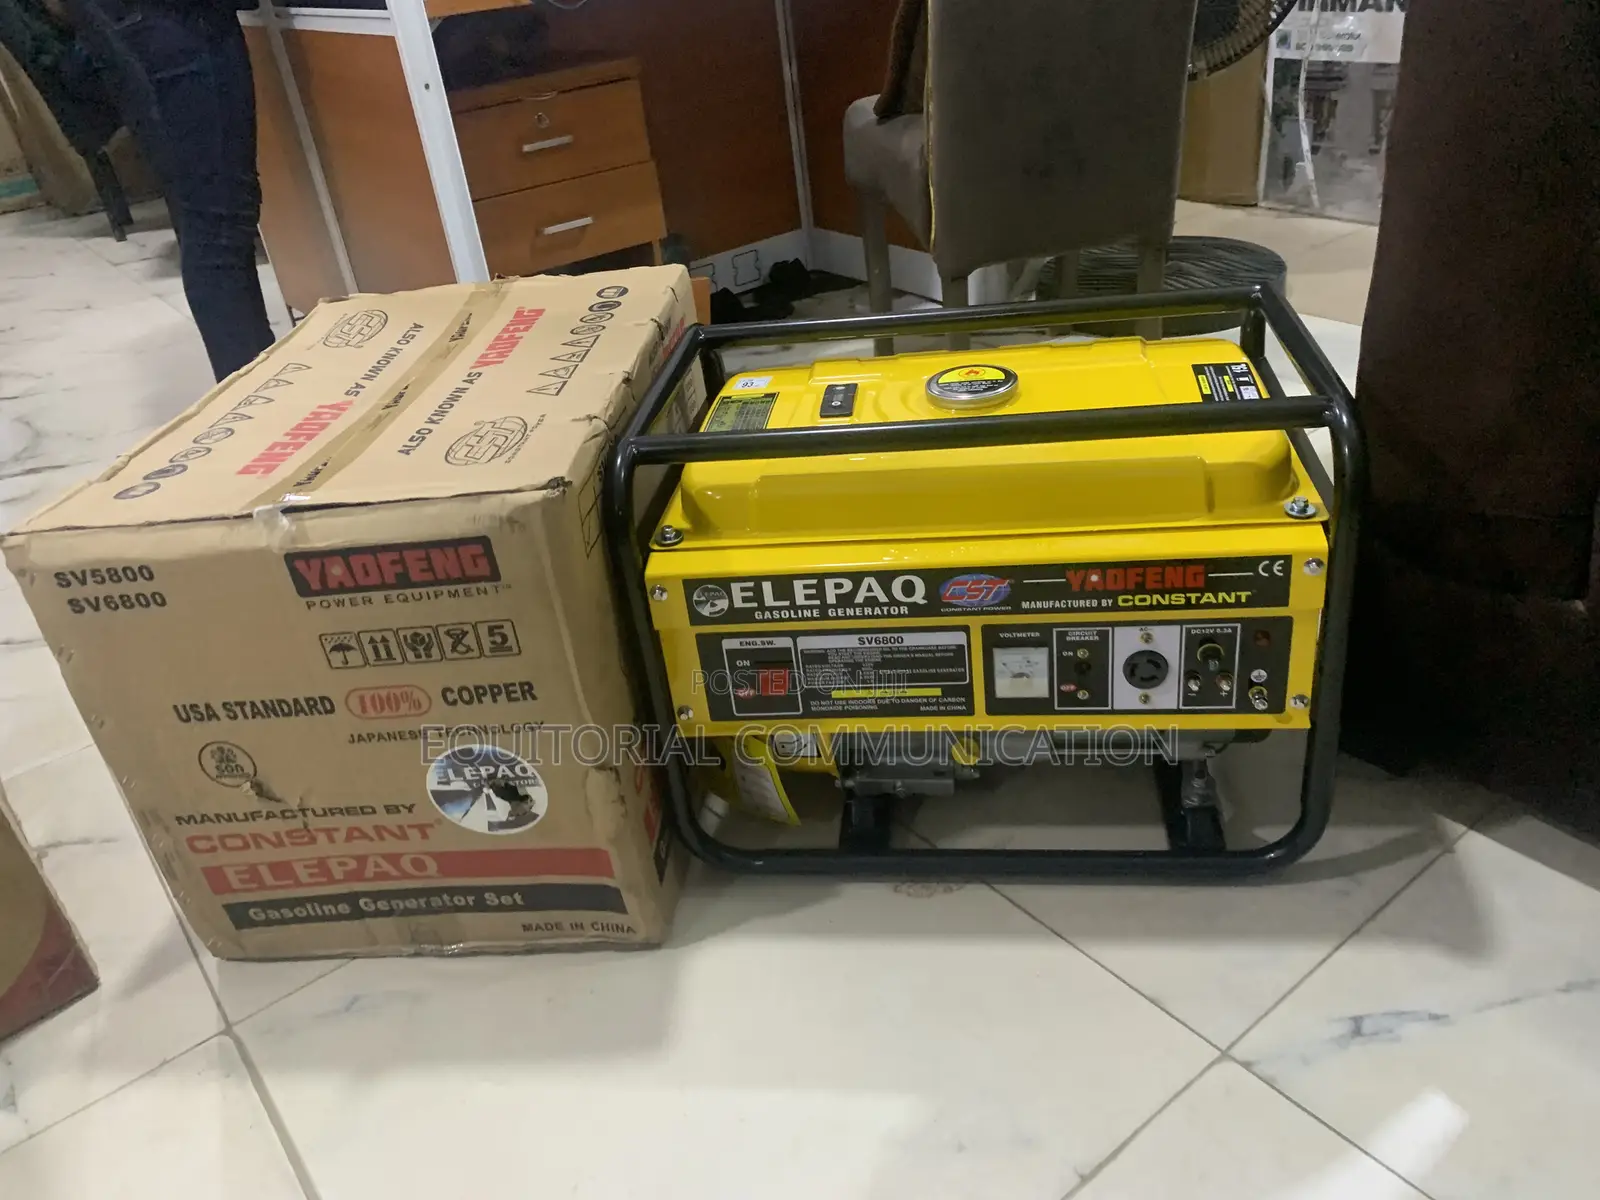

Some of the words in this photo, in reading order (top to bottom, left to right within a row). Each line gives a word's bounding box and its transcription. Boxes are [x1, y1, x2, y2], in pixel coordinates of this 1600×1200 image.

[401, 322, 425, 347] ALSO
[469, 308, 546, 370] YAOFENG
[360, 346, 403, 381] KNOWN
[343, 382, 366, 397] AS
[462, 371, 483, 385] AS
[424, 386, 470, 425] KNOWN
[235, 400, 354, 477] YAOFENG
[397, 427, 434, 456] ALSO
[54, 565, 154, 588] SV5800
[293, 543, 491, 591] YAOFENG
[1066, 564, 1206, 592] YAOFENG
[1258, 559, 1285, 577] CE
[67, 591, 167, 614] SV6800
[305, 595, 374, 610] POWER
[730, 574, 928, 608] ELEPAQ
[940, 578, 1012, 603] CST
[1021, 600, 1098, 609] MANUFACTURED
[1101, 598, 1113, 607] BY
[1117, 591, 1252, 607] CONSTANT
[755, 608, 820, 620] GASOLINE
[828, 605, 909, 617] GENERATOR
[857, 635, 904, 646] SV6800
[736, 659, 751, 667] ON
[172, 703, 221, 723] USA
[222, 695, 336, 721] STANDARD
[353, 689, 422, 715] 100%
[441, 680, 538, 707] COPPER
[348, 728, 429, 744] JAPANESE
[436, 721, 545, 738] TECHNOLOGY
[175, 804, 377, 825] MANUFACTURED
[385, 803, 416, 815] BY
[184, 822, 436, 854] CONSTANT
[222, 853, 441, 890] ELEPAQ
[248, 899, 351, 921] Gasoline
[358, 893, 476, 912] Generator
[483, 891, 525, 906] Set
[521, 921, 564, 933] MADE
[569, 921, 585, 932] IN
[591, 922, 636, 934] CHINA
